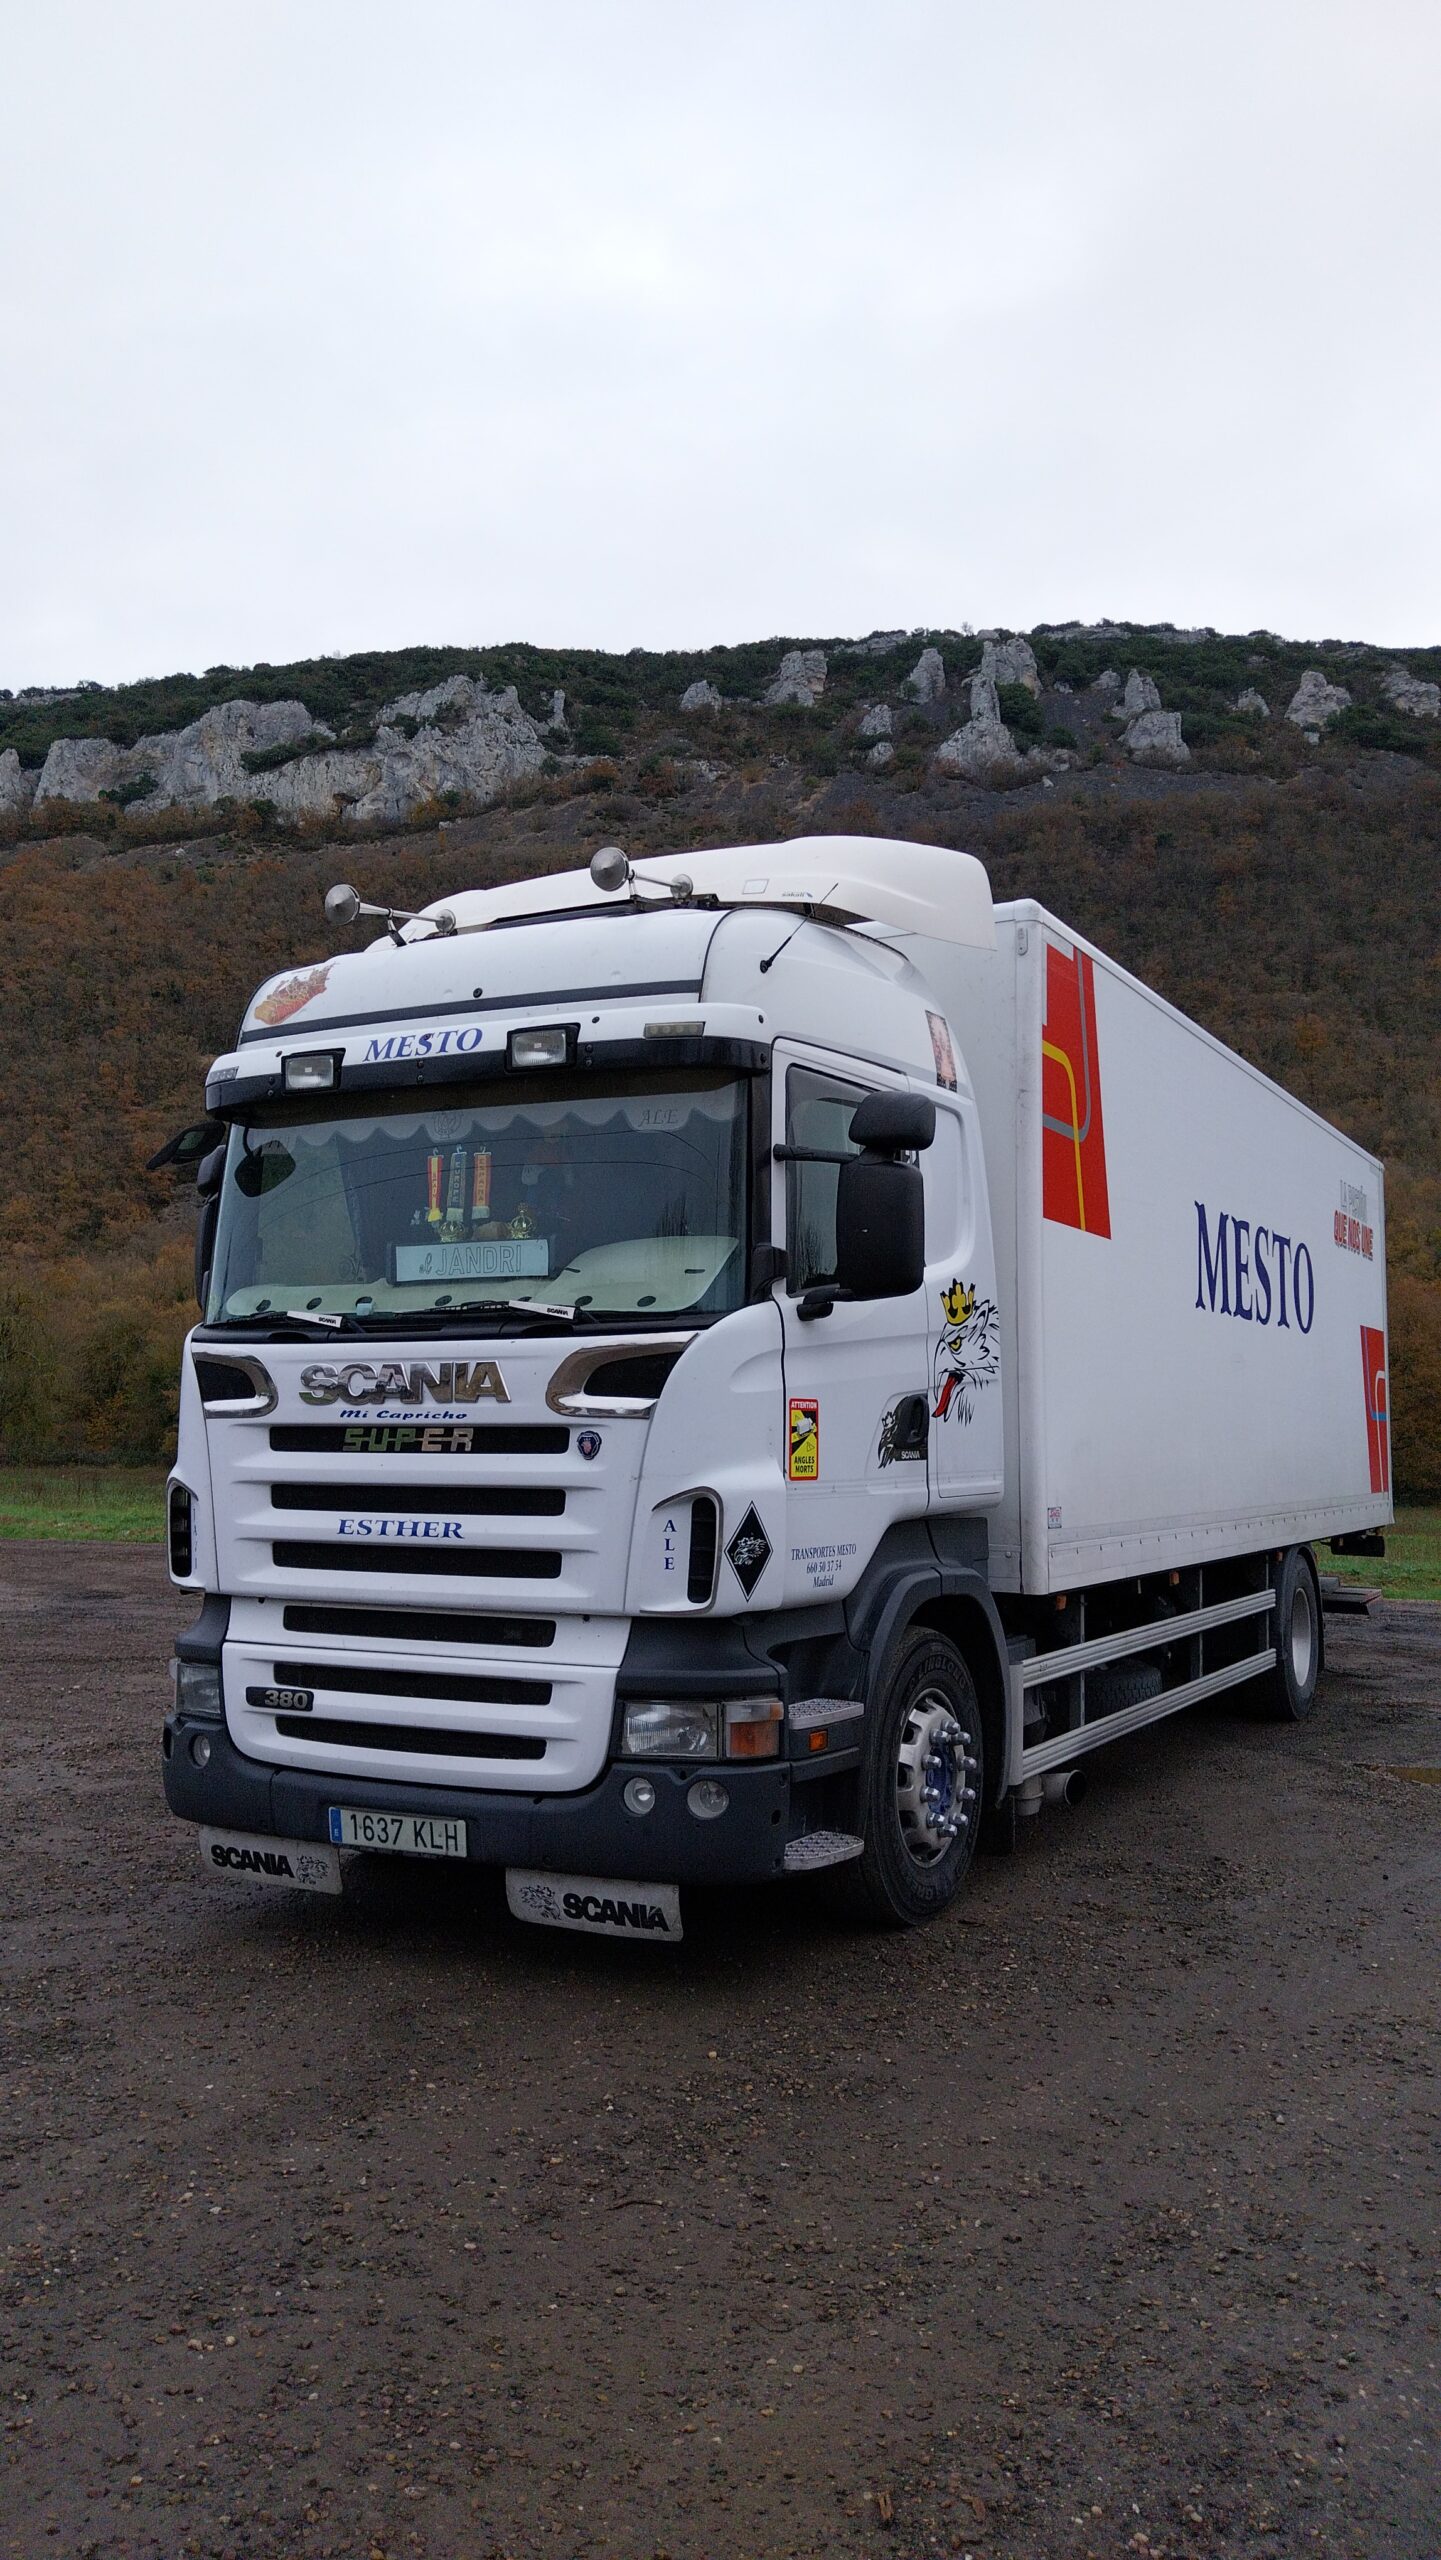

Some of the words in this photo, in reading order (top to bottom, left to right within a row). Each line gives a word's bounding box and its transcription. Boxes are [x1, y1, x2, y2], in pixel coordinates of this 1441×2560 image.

[362, 1028, 483, 1062] MESTO
[436, 1244, 522, 1276] JANDRI
[1194, 1200, 1314, 1334] MESTO
[547, 1307, 569, 1316] SCANIA
[299, 1360, 512, 1406] SCANIA
[340, 1409, 368, 1419] Mi
[376, 1410, 468, 1421] Capricho
[791, 1401, 817, 1409] ATTENTION
[342, 1427, 474, 1451] SUPER
[794, 1456, 815, 1464] ANGLES
[901, 1450, 920, 1460] SCANIA
[795, 1465, 814, 1473] MORTS
[337, 1519, 465, 1539] ESTHER
[663, 1519, 677, 1571] ALE
[791, 1545, 836, 1560] TRANSPORTES
[837, 1543, 857, 1556] MESTO
[806, 1561, 817, 1574] 660
[827, 1560, 834, 1572] 37
[813, 1575, 834, 1588] Madrid
[264, 1689, 308, 1709] 380
[350, 1814, 403, 1845] 1637
[413, 1820, 459, 1852] KLH
[210, 1844, 295, 1879] SCANIA
[563, 1893, 671, 1932] SCANIA
